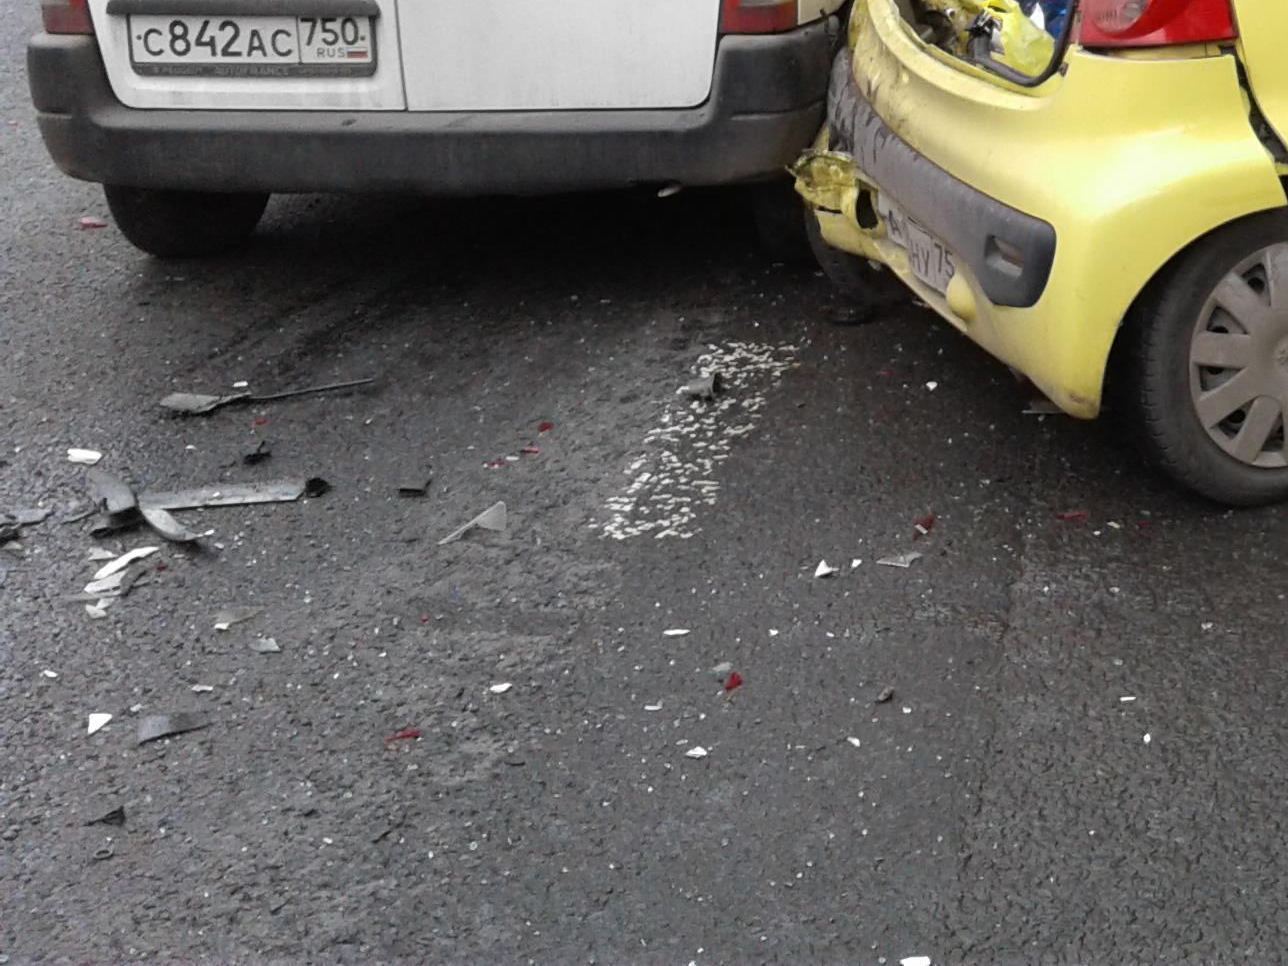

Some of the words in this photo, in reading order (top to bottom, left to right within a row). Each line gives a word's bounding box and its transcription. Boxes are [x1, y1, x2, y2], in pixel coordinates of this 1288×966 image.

[143, 19, 293, 57] С842АС
[300, 17, 360, 46] 750
[316, 47, 346, 58] RUS
